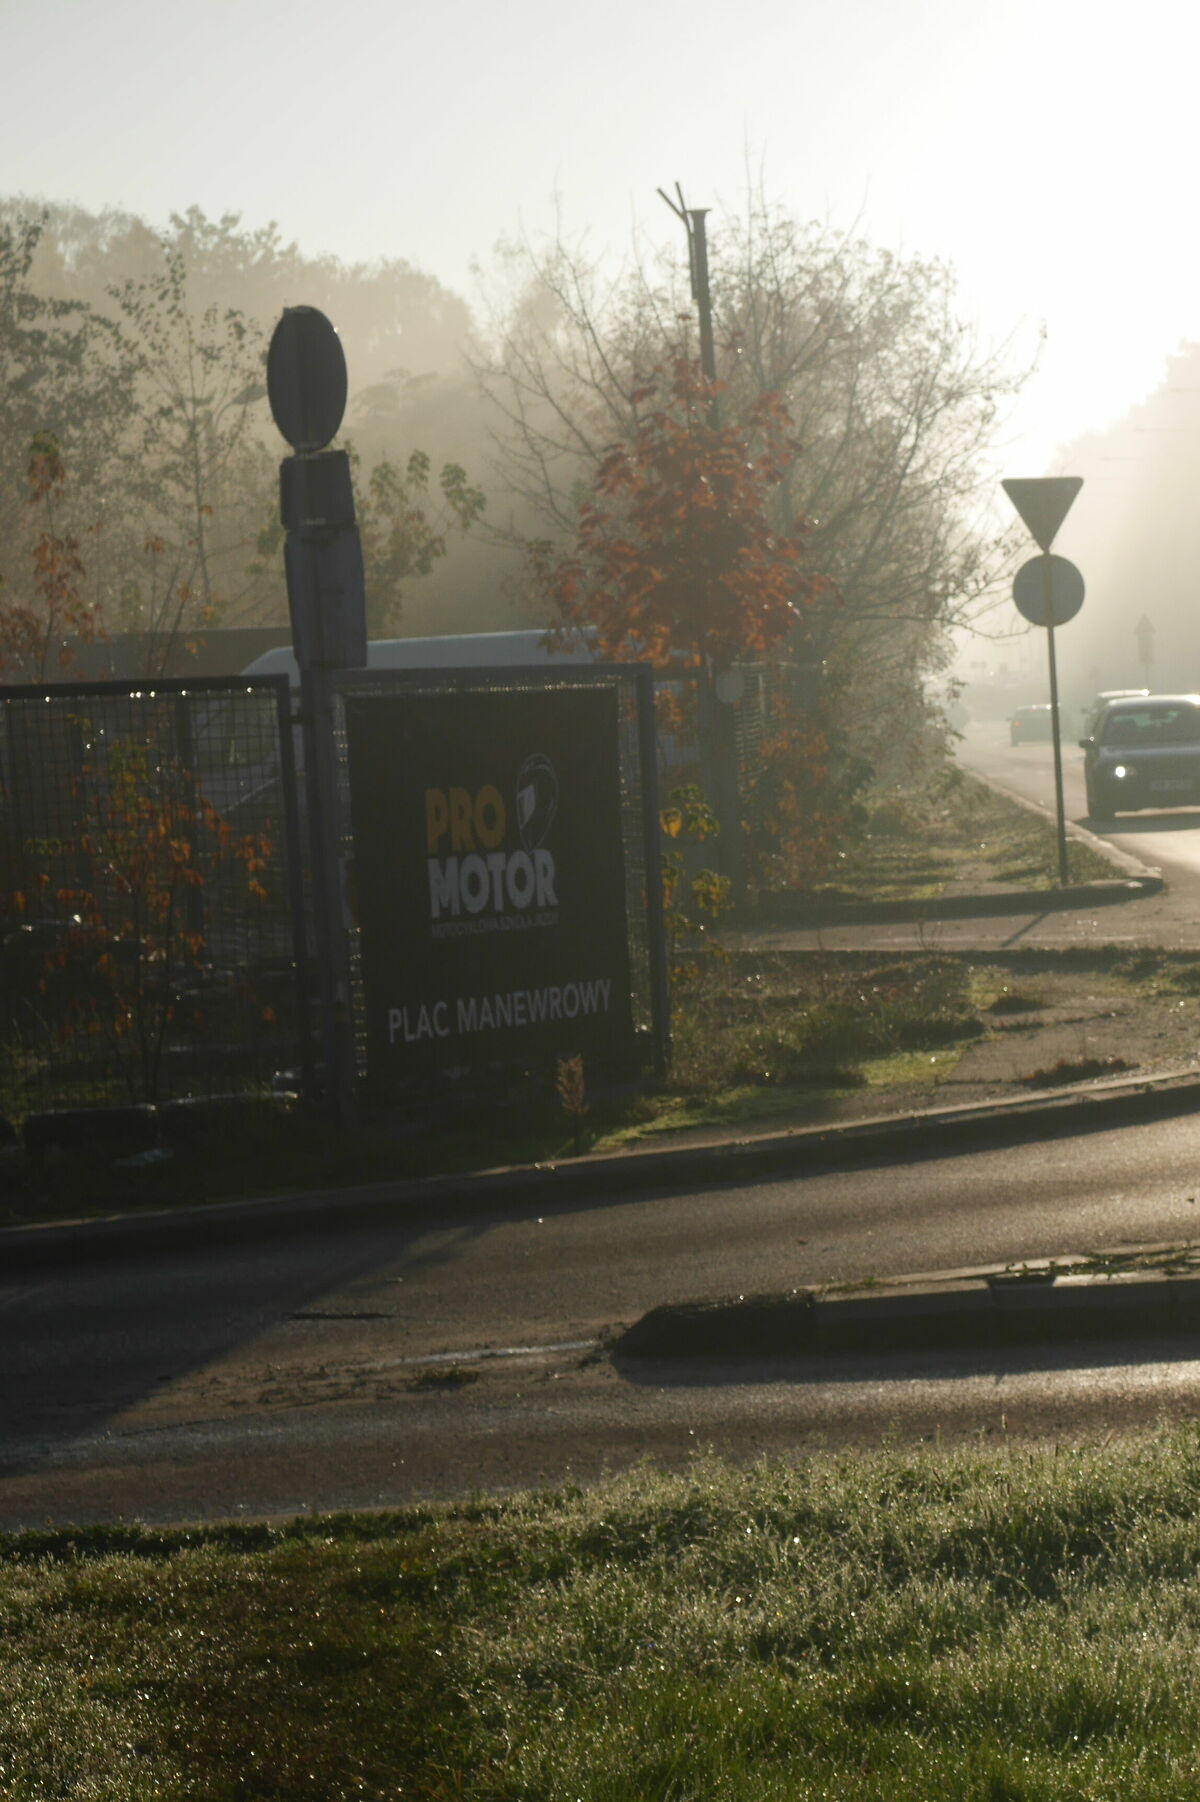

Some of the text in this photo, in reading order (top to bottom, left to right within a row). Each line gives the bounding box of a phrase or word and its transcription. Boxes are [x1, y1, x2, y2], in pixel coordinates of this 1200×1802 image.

[425, 785, 506, 852] PRO
[428, 850, 558, 918] MOTOR
[388, 979, 611, 1043] PLAC MANEWROWY
